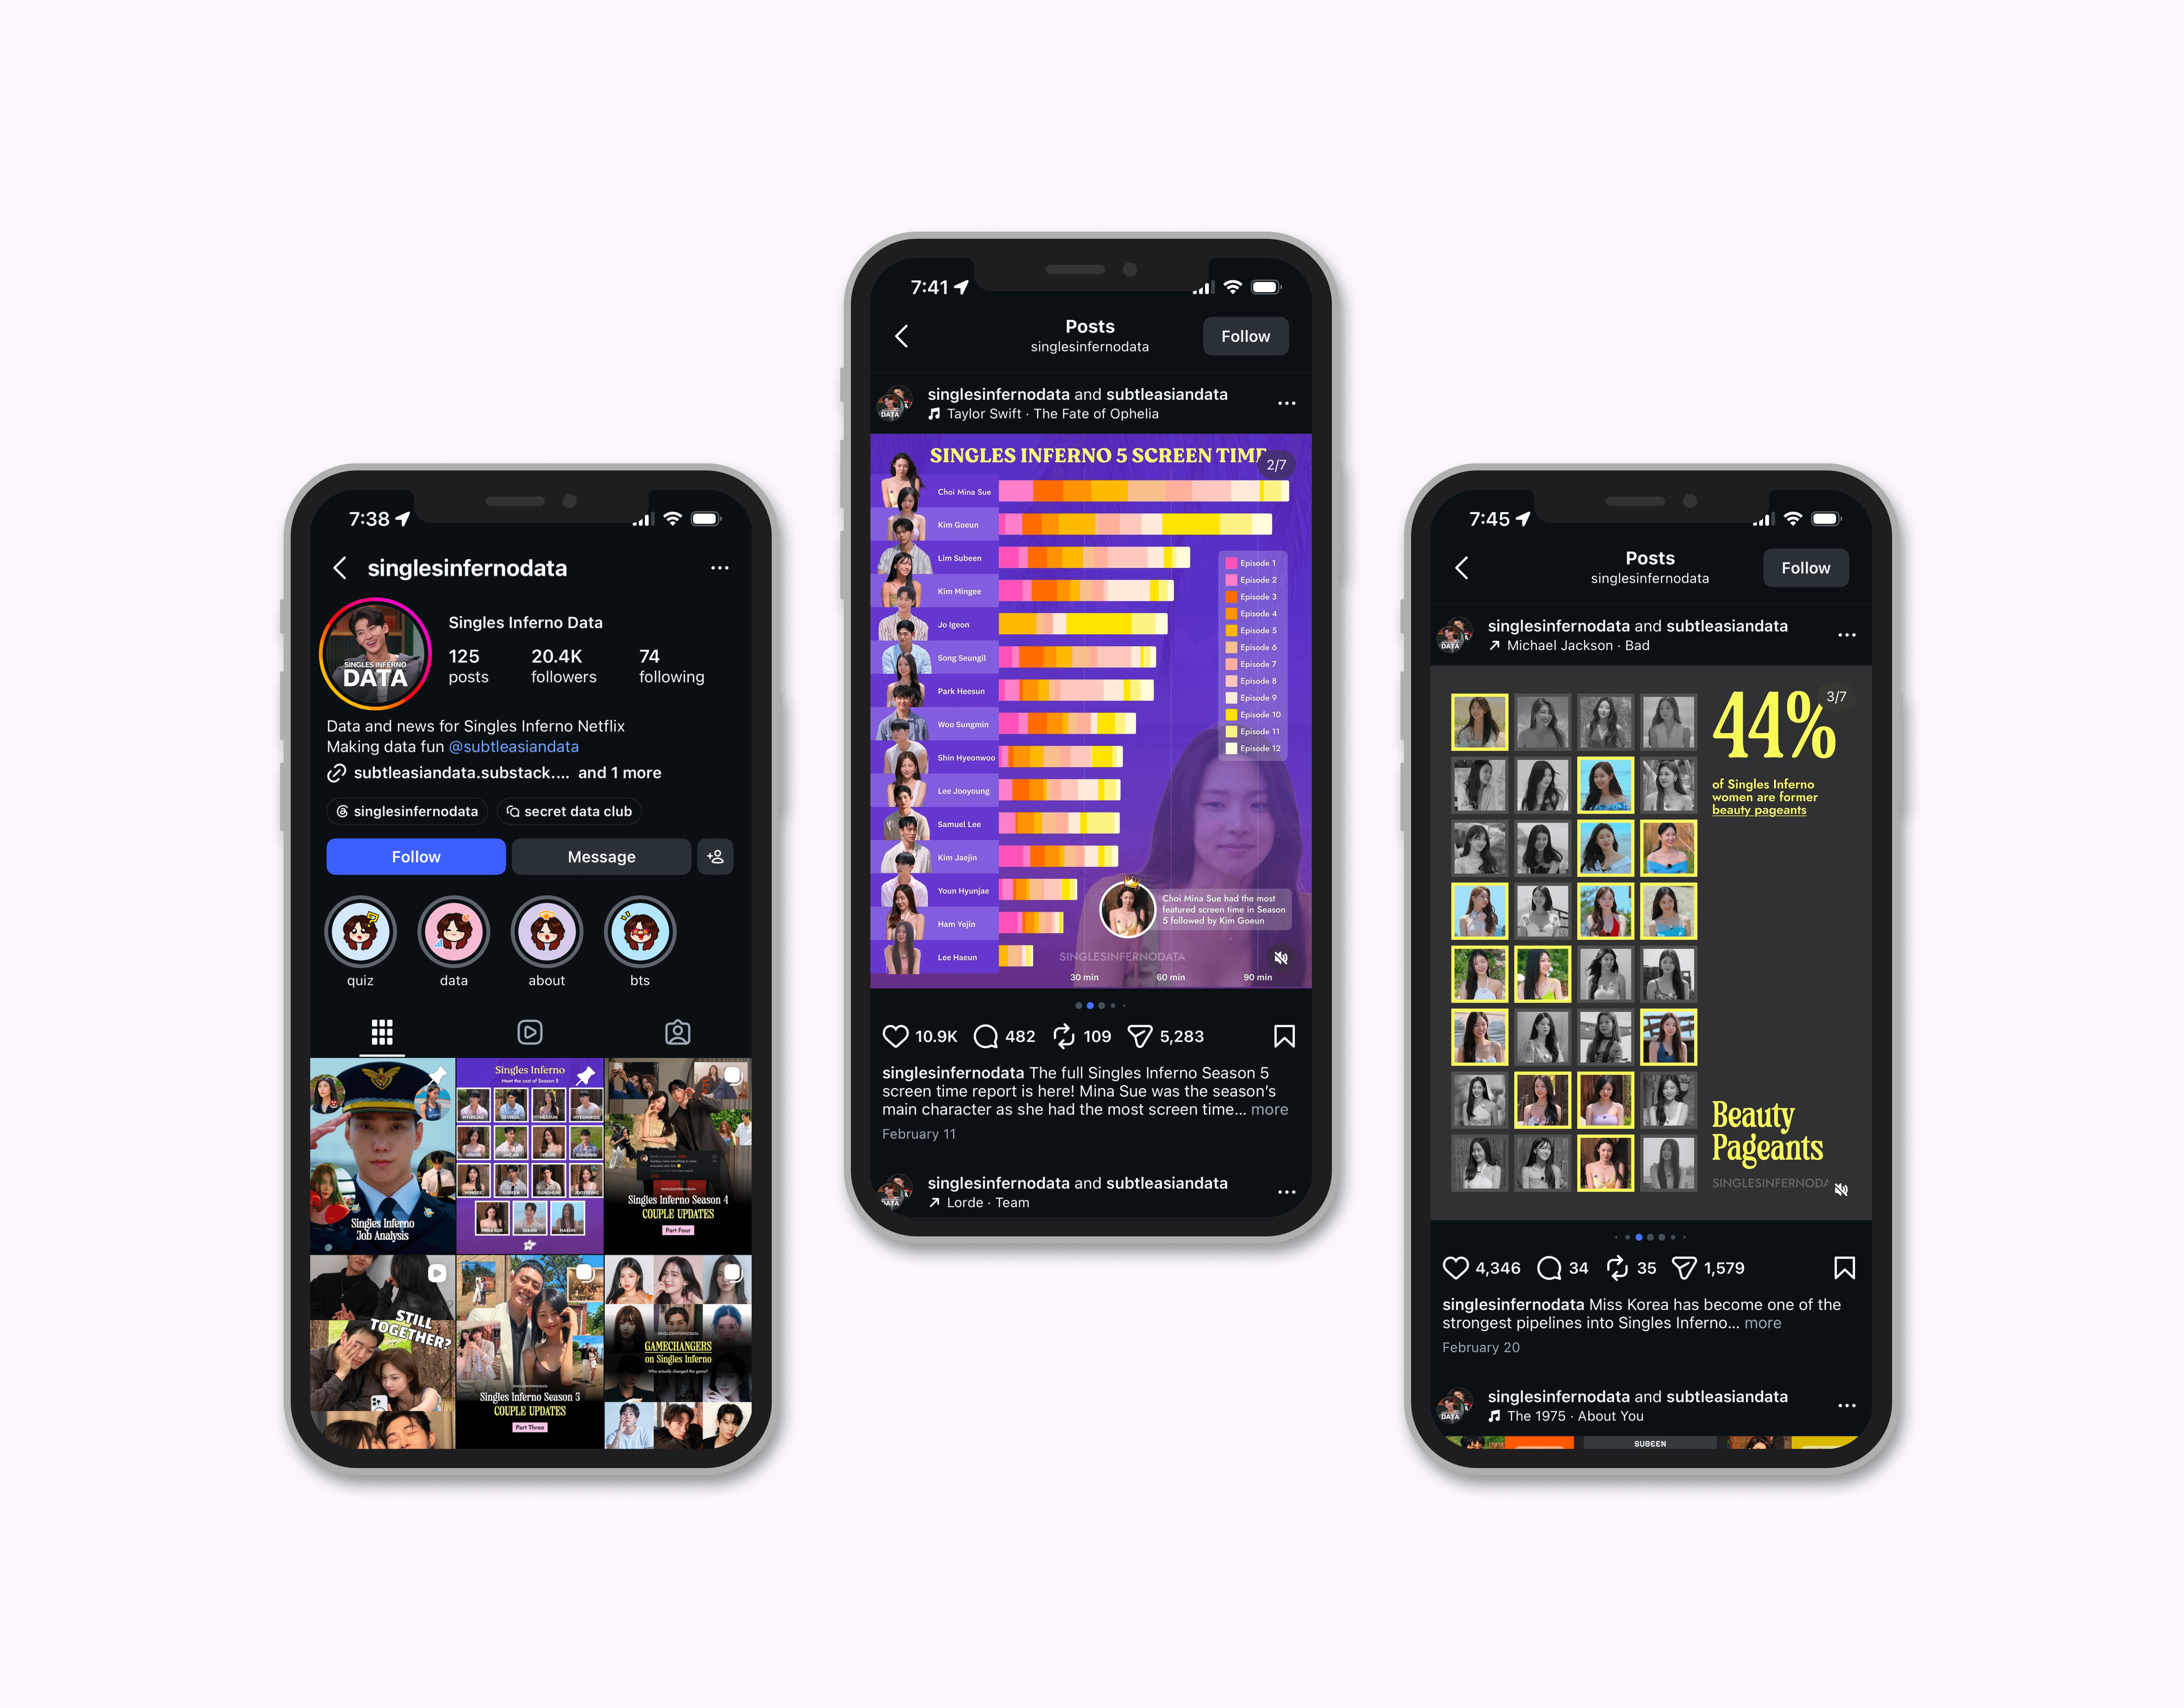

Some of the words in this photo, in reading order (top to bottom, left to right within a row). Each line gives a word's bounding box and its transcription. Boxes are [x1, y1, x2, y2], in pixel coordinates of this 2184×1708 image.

[911, 281, 947, 294] 7:41
[1067, 320, 1114, 333] Posts
[1223, 330, 1270, 342] Follow
[1031, 341, 1148, 354] singlesinfernodata
[929, 388, 1069, 403] singlesinfernodata
[1075, 388, 1101, 400] and
[1107, 388, 1227, 400] subtleasiandata
[947, 408, 985, 421] Taylor
[990, 408, 1021, 419] Swift
[1034, 408, 1057, 418] The
[1063, 409, 1089, 418] Fate
[1094, 408, 1106, 418] of
[1111, 408, 1158, 421] Ophelia
[930, 448, 1016, 463] SINGLES
[1021, 448, 1111, 463] INFERNO
[1116, 448, 1127, 463] 5
[1132, 448, 1212, 463] SCREEN
[1267, 459, 1286, 472] 2/7
[350, 512, 389, 526] 7:38
[1470, 512, 1510, 526] 7:45
[368, 558, 566, 580] singlesinfernodata
[1241, 559, 1269, 568] Episode
[449, 616, 504, 631] Singles
[510, 616, 563, 628] Inferno
[568, 617, 602, 628] Data
[1508, 640, 1556, 650] Michael
[1561, 640, 1612, 650] Jackson
[1626, 640, 1649, 650] Bad
[449, 649, 479, 663] 125
[532, 649, 582, 663] 20.4K
[640, 650, 659, 663] 74
[344, 669, 408, 686] DATA
[449, 672, 488, 685] posts
[531, 671, 596, 682] followers
[639, 671, 704, 685] following
[1827, 691, 1846, 704] 3/7
[328, 720, 360, 732] Data
[366, 720, 391, 732] and
[398, 723, 434, 732] news
[439, 720, 459, 732] for
[464, 720, 516, 735] Singles
[523, 720, 572, 732] Inferno
[579, 720, 624, 732] Netflix
[1713, 691, 1837, 758] 44%
[328, 740, 379, 755] Making
[384, 740, 415, 752] data
[421, 740, 444, 752] fun
[449, 740, 578, 754] @subtleasiandata
[1241, 745, 1269, 753] Episode
[579, 766, 606, 779] and
[612, 767, 617, 778] 1
[624, 769, 661, 779] more
[1712, 778, 1724, 789] of
[1728, 779, 1769, 792] Singles
[1774, 778, 1814, 789] Inferno
[1779, 791, 1818, 801] former
[355, 806, 477, 819] singlesinfernodata
[1712, 804, 1751, 817] beauty
[1755, 806, 1807, 817] pageants
[393, 851, 440, 862] Follow
[569, 851, 635, 865] Message
[1060, 952, 1185, 961] SINGLESINFERNODATA
[348, 975, 373, 988] quiz
[440, 975, 467, 985] data
[529, 975, 565, 985] about
[631, 975, 650, 985] bts
[916, 1030, 957, 1042] 10.9K
[1161, 1030, 1203, 1045] 5,283
[496, 1066, 528, 1075] Singles
[1712, 1101, 1795, 1135] Beauty
[1712, 1133, 1823, 1169] Pageants
[629, 1195, 657, 1207] Singles
[660, 1195, 689, 1204] Inferno
[693, 1195, 721, 1204] Season
[724, 1195, 728, 1204] 4
[643, 1209, 674, 1219] COUPLE
[678, 1209, 714, 1219] UPDATES
[351, 1218, 381, 1230] Singles
[384, 1218, 414, 1228] Inferno
[357, 1231, 372, 1240] Job
[374, 1230, 409, 1242] Analysis
[1476, 1262, 1520, 1277] 4,346
[1705, 1262, 1744, 1277] 1,579
[1443, 1298, 1584, 1313] singlesinfernodata
[1590, 1298, 1622, 1310] Miss
[1628, 1299, 1668, 1310] Korea
[1674, 1298, 1699, 1310] has
[1705, 1298, 1762, 1310] become
[1768, 1301, 1794, 1310] one
[1800, 1298, 1813, 1310] of
[1818, 1298, 1841, 1310] the
[396, 1309, 433, 1330] STILL
[370, 1318, 452, 1350] TOGETHER?
[645, 1342, 711, 1351] GAMECHANGERS
[1443, 1342, 1499, 1355] February
[1504, 1342, 1519, 1352] 20
[657, 1355, 682, 1365] Singles
